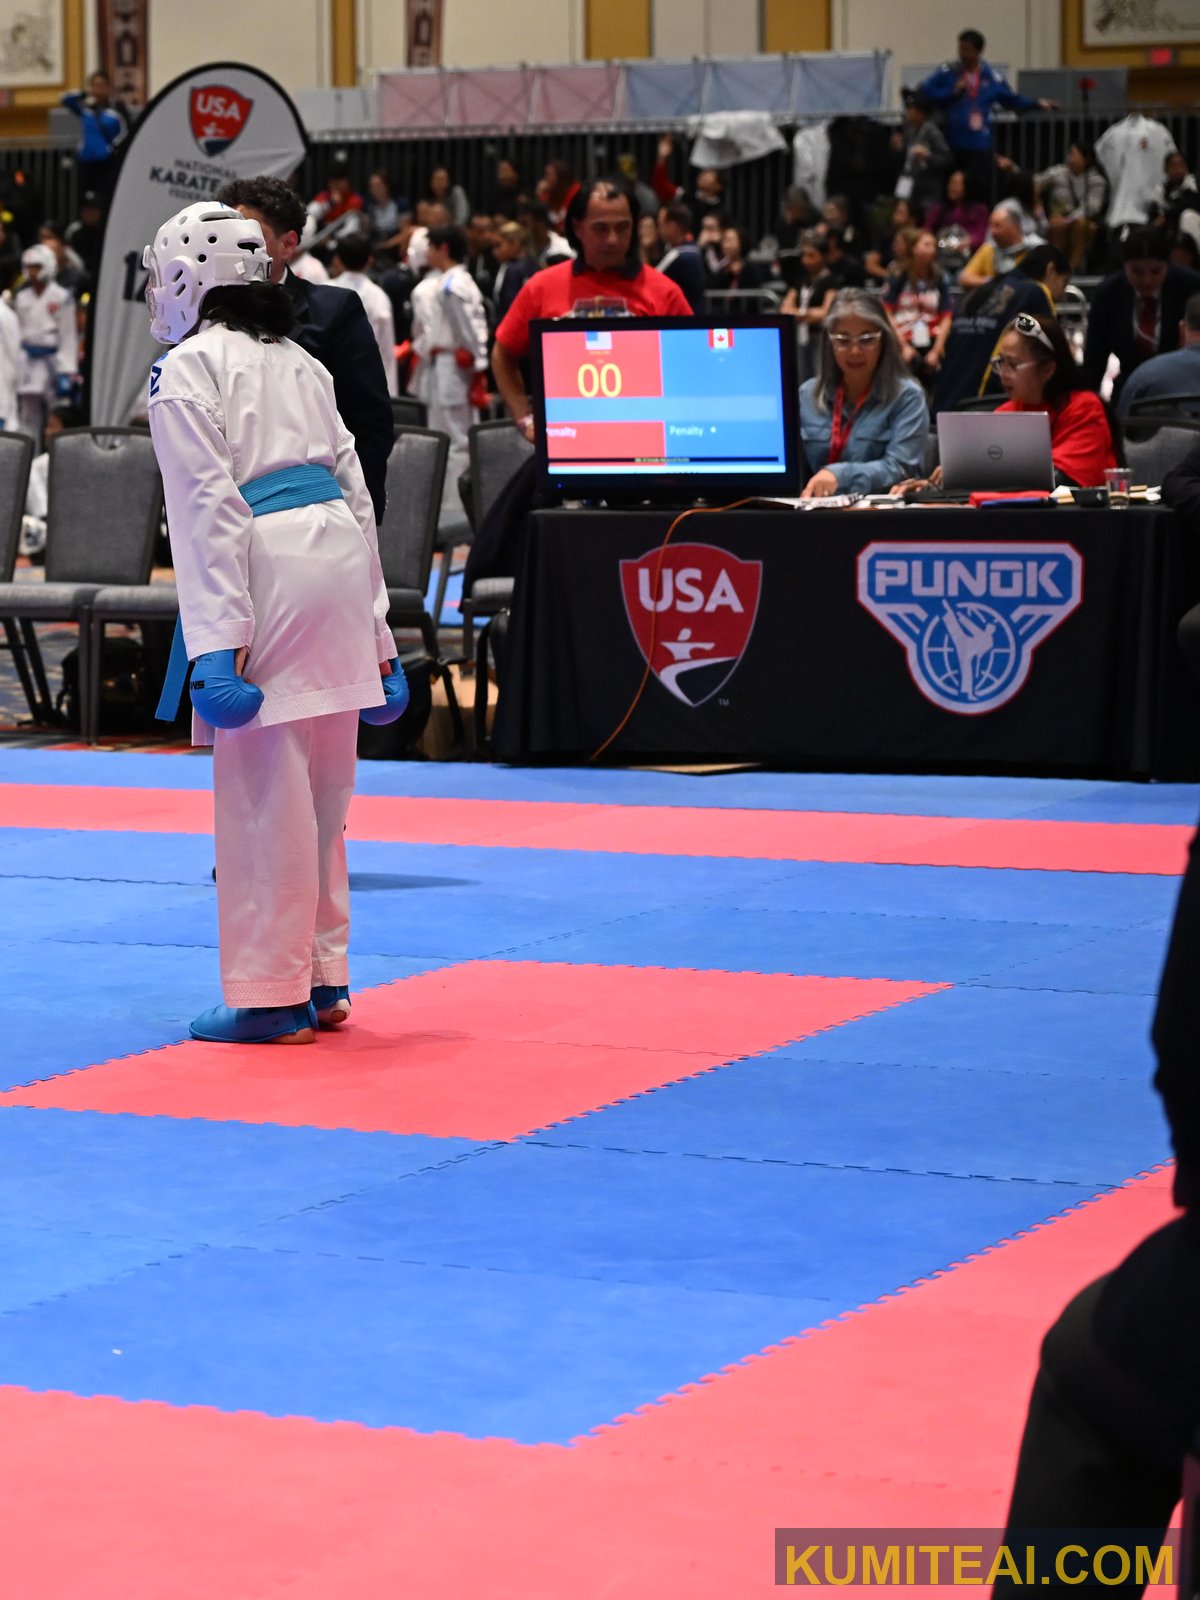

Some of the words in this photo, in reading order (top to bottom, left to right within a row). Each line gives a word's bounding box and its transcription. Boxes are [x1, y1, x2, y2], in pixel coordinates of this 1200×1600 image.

[196, 94, 240, 121] USA
[149, 165, 221, 193] KARATE
[174, 159, 236, 179] NATIONAL
[577, 363, 622, 398] 00
[669, 425, 704, 437] Penalty
[638, 567, 745, 613] USA
[875, 560, 1063, 598] PUNOK
[719, 698, 730, 706] TM
